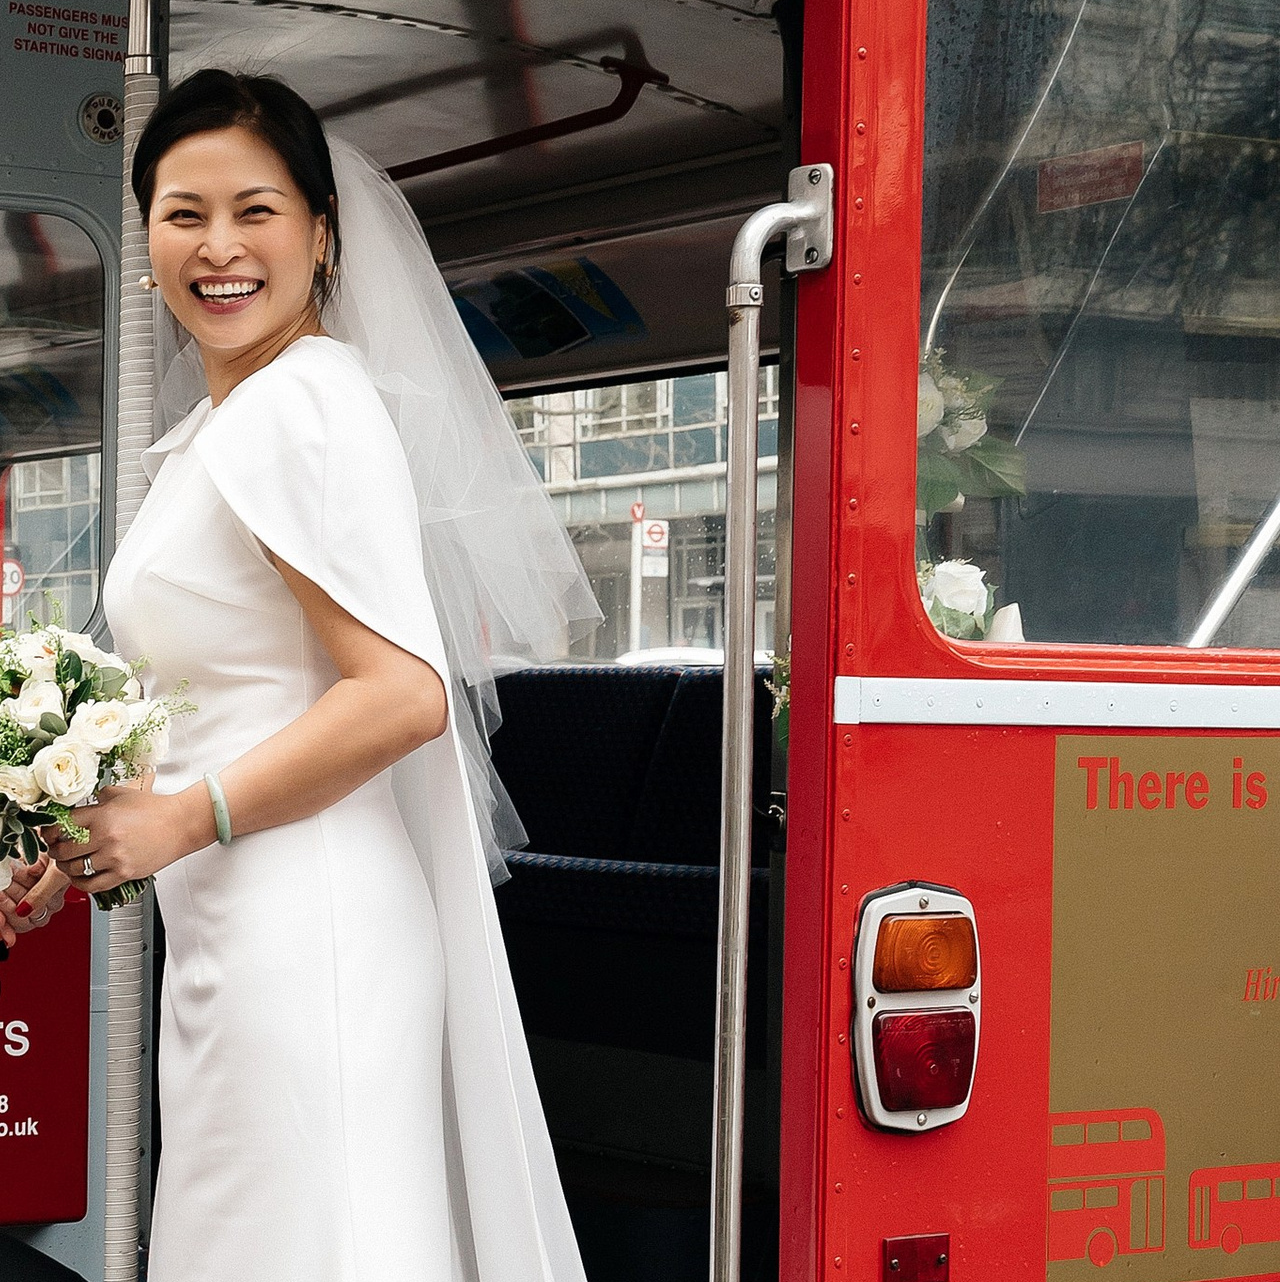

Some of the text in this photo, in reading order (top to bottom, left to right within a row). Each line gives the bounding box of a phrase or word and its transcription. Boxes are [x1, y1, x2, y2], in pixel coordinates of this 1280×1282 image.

[8, 1, 129, 29] PASSENGERS MUS
[27, 22, 119, 45] NOT GIVE THE
[13, 38, 79, 58] STARTING
[90, 98, 121, 113] PUSH
[1077, 755, 1269, 810] There is
